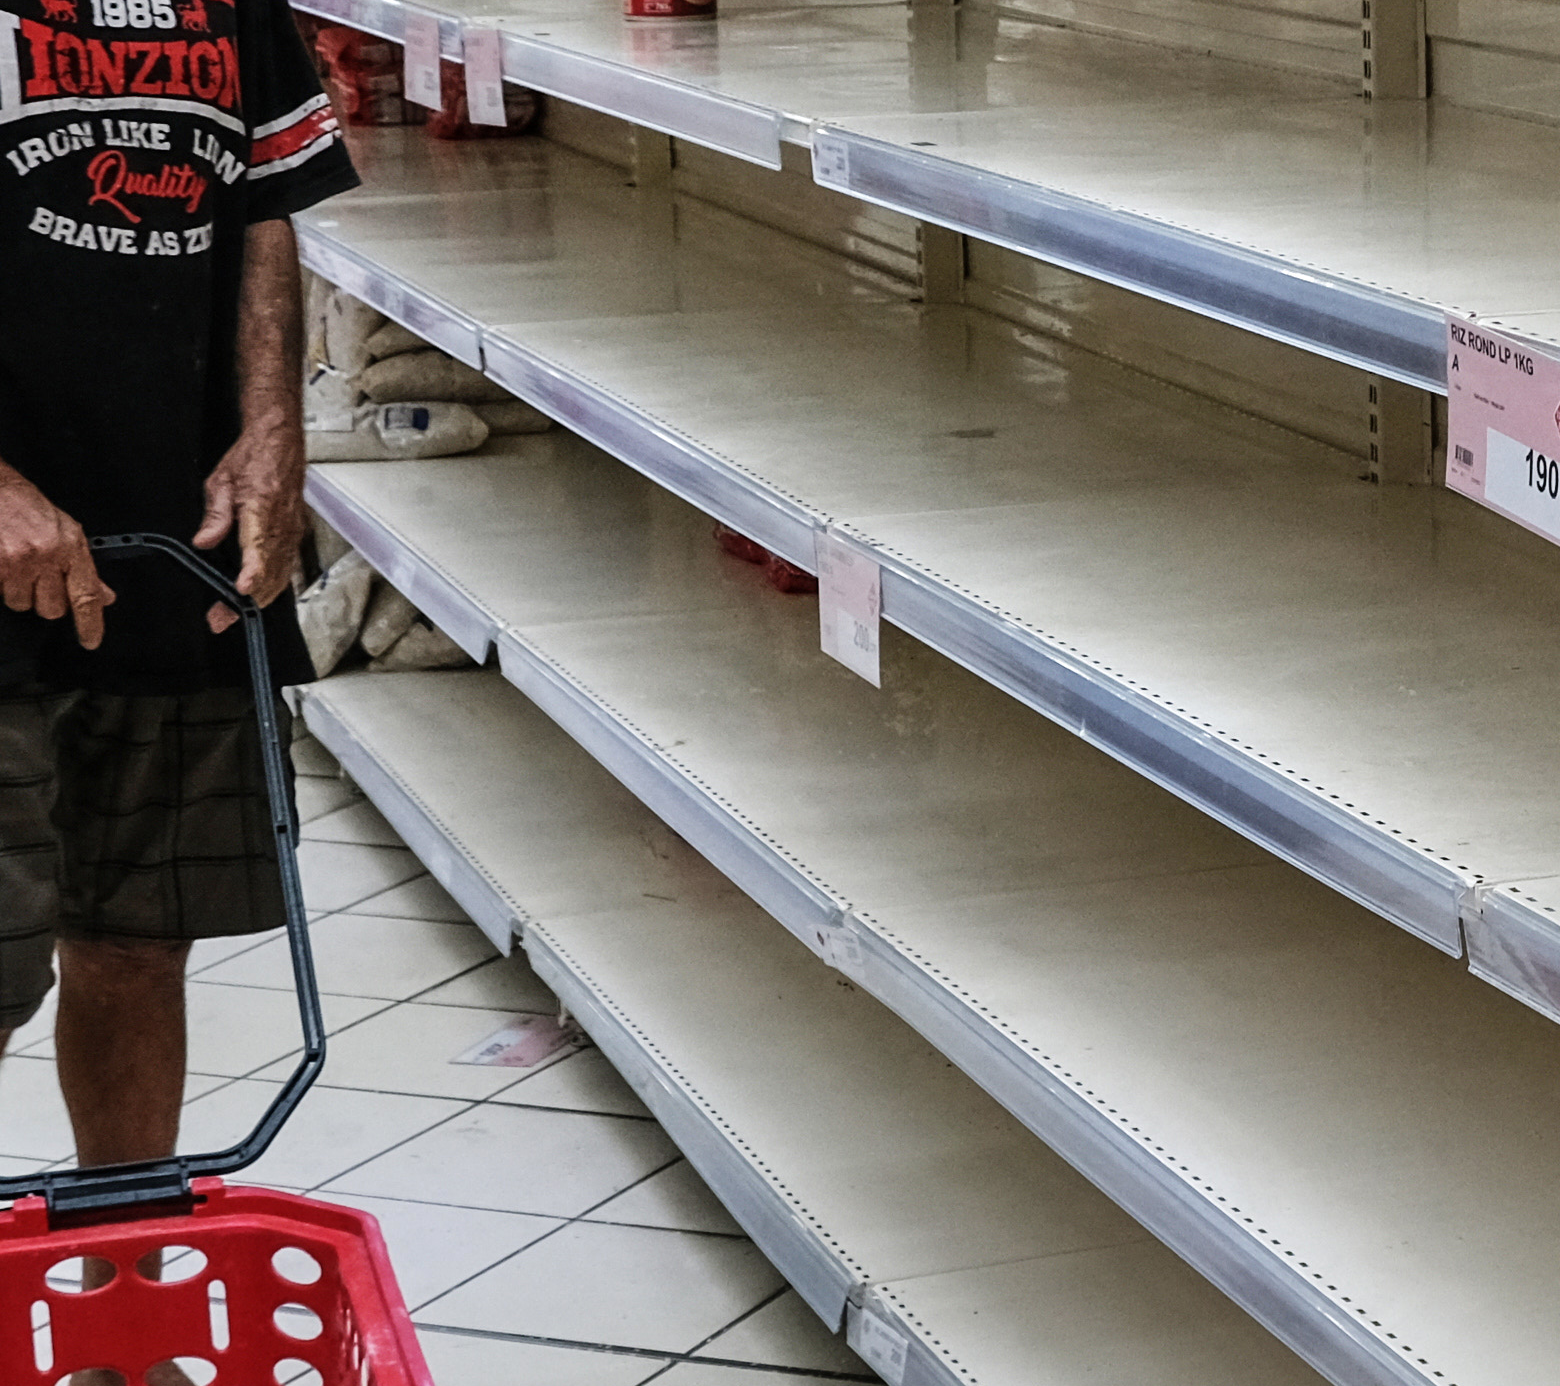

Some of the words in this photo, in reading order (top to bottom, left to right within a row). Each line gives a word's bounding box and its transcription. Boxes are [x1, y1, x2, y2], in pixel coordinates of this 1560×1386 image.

[6, 120, 95, 176] IRON
[102, 118, 171, 151] LIKE
[86, 149, 208, 223] Quality
[28, 206, 138, 254] BRAVE
[144, 230, 181, 256] AS
[1451, 324, 1466, 346] RIZ
[1468, 334, 1496, 359] ROND
[1499, 348, 1511, 365] LP
[1514, 355, 1534, 376] 1KG
[1452, 354, 1460, 372] A
[1526, 448, 1559, 499] 190
